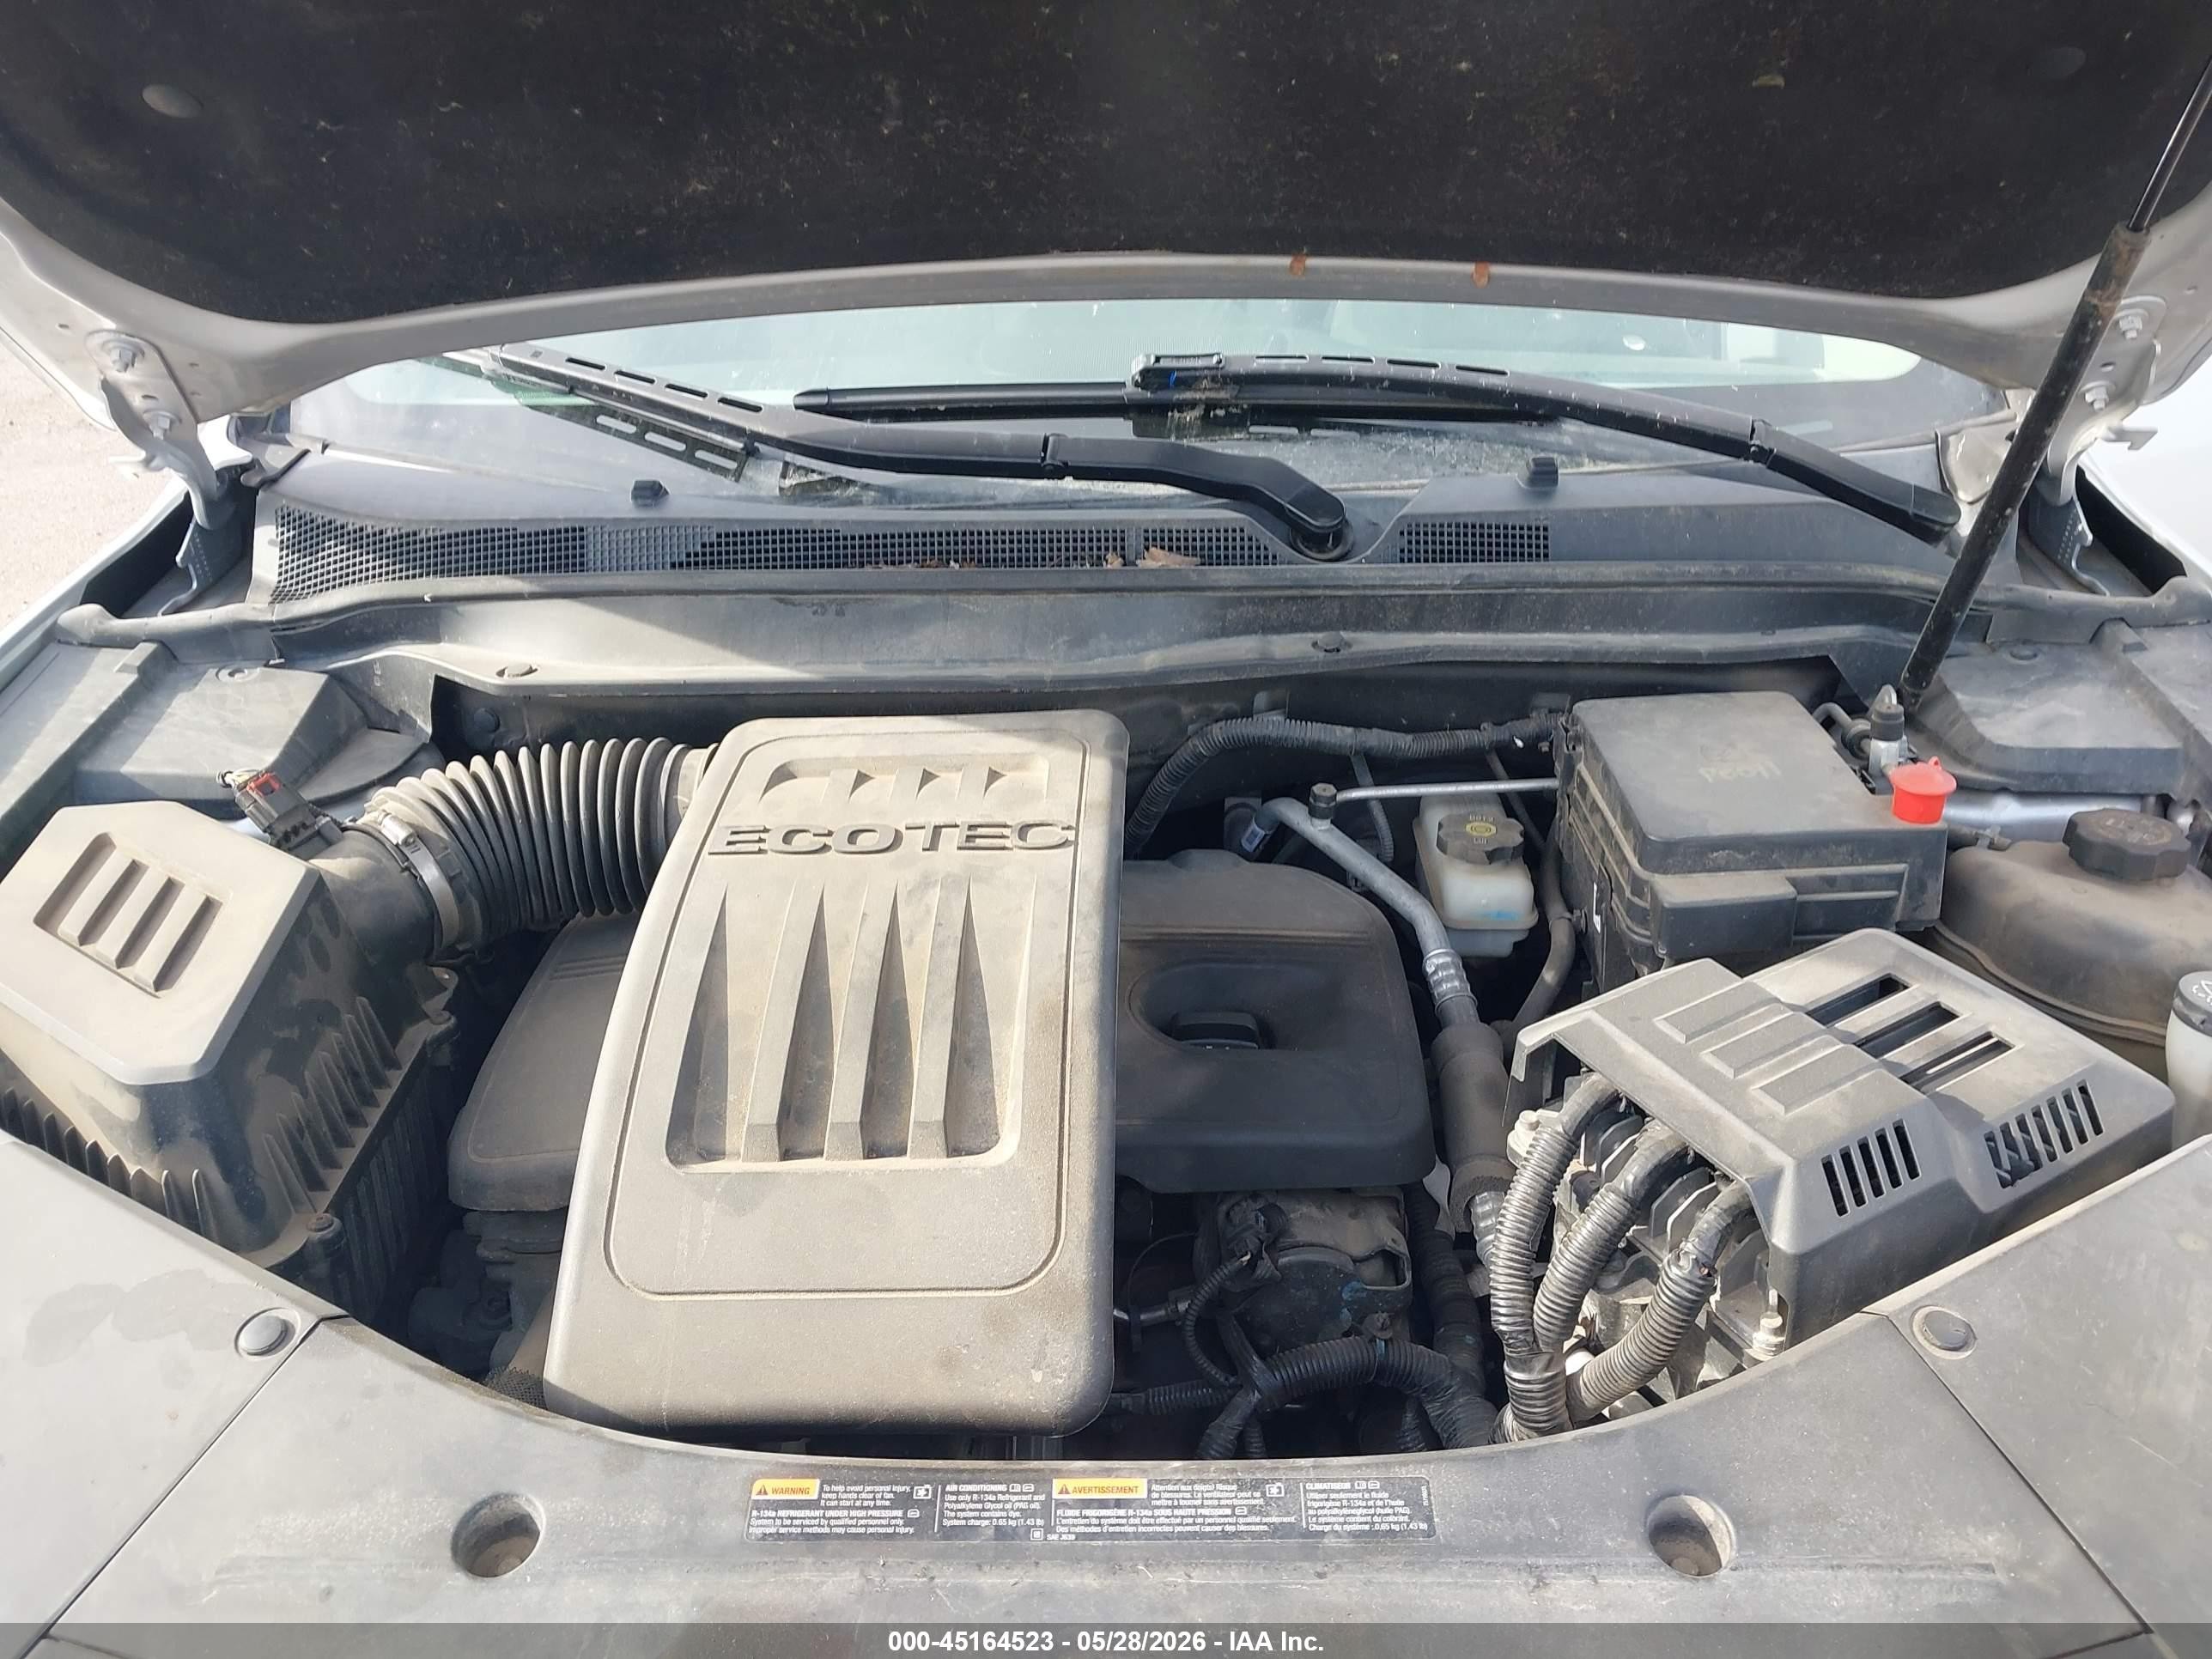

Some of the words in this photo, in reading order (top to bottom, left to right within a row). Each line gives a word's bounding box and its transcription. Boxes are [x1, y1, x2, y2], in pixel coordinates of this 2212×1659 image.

[708, 819, 1076, 854] ECOTEC
[771, 1486, 810, 1495] WARNING
[831, 1485, 845, 1493] help
[864, 1485, 891, 1493] personal
[957, 1510, 979, 1519] system
[750, 1518, 774, 1527] System
[830, 1517, 856, 1527] qualified
